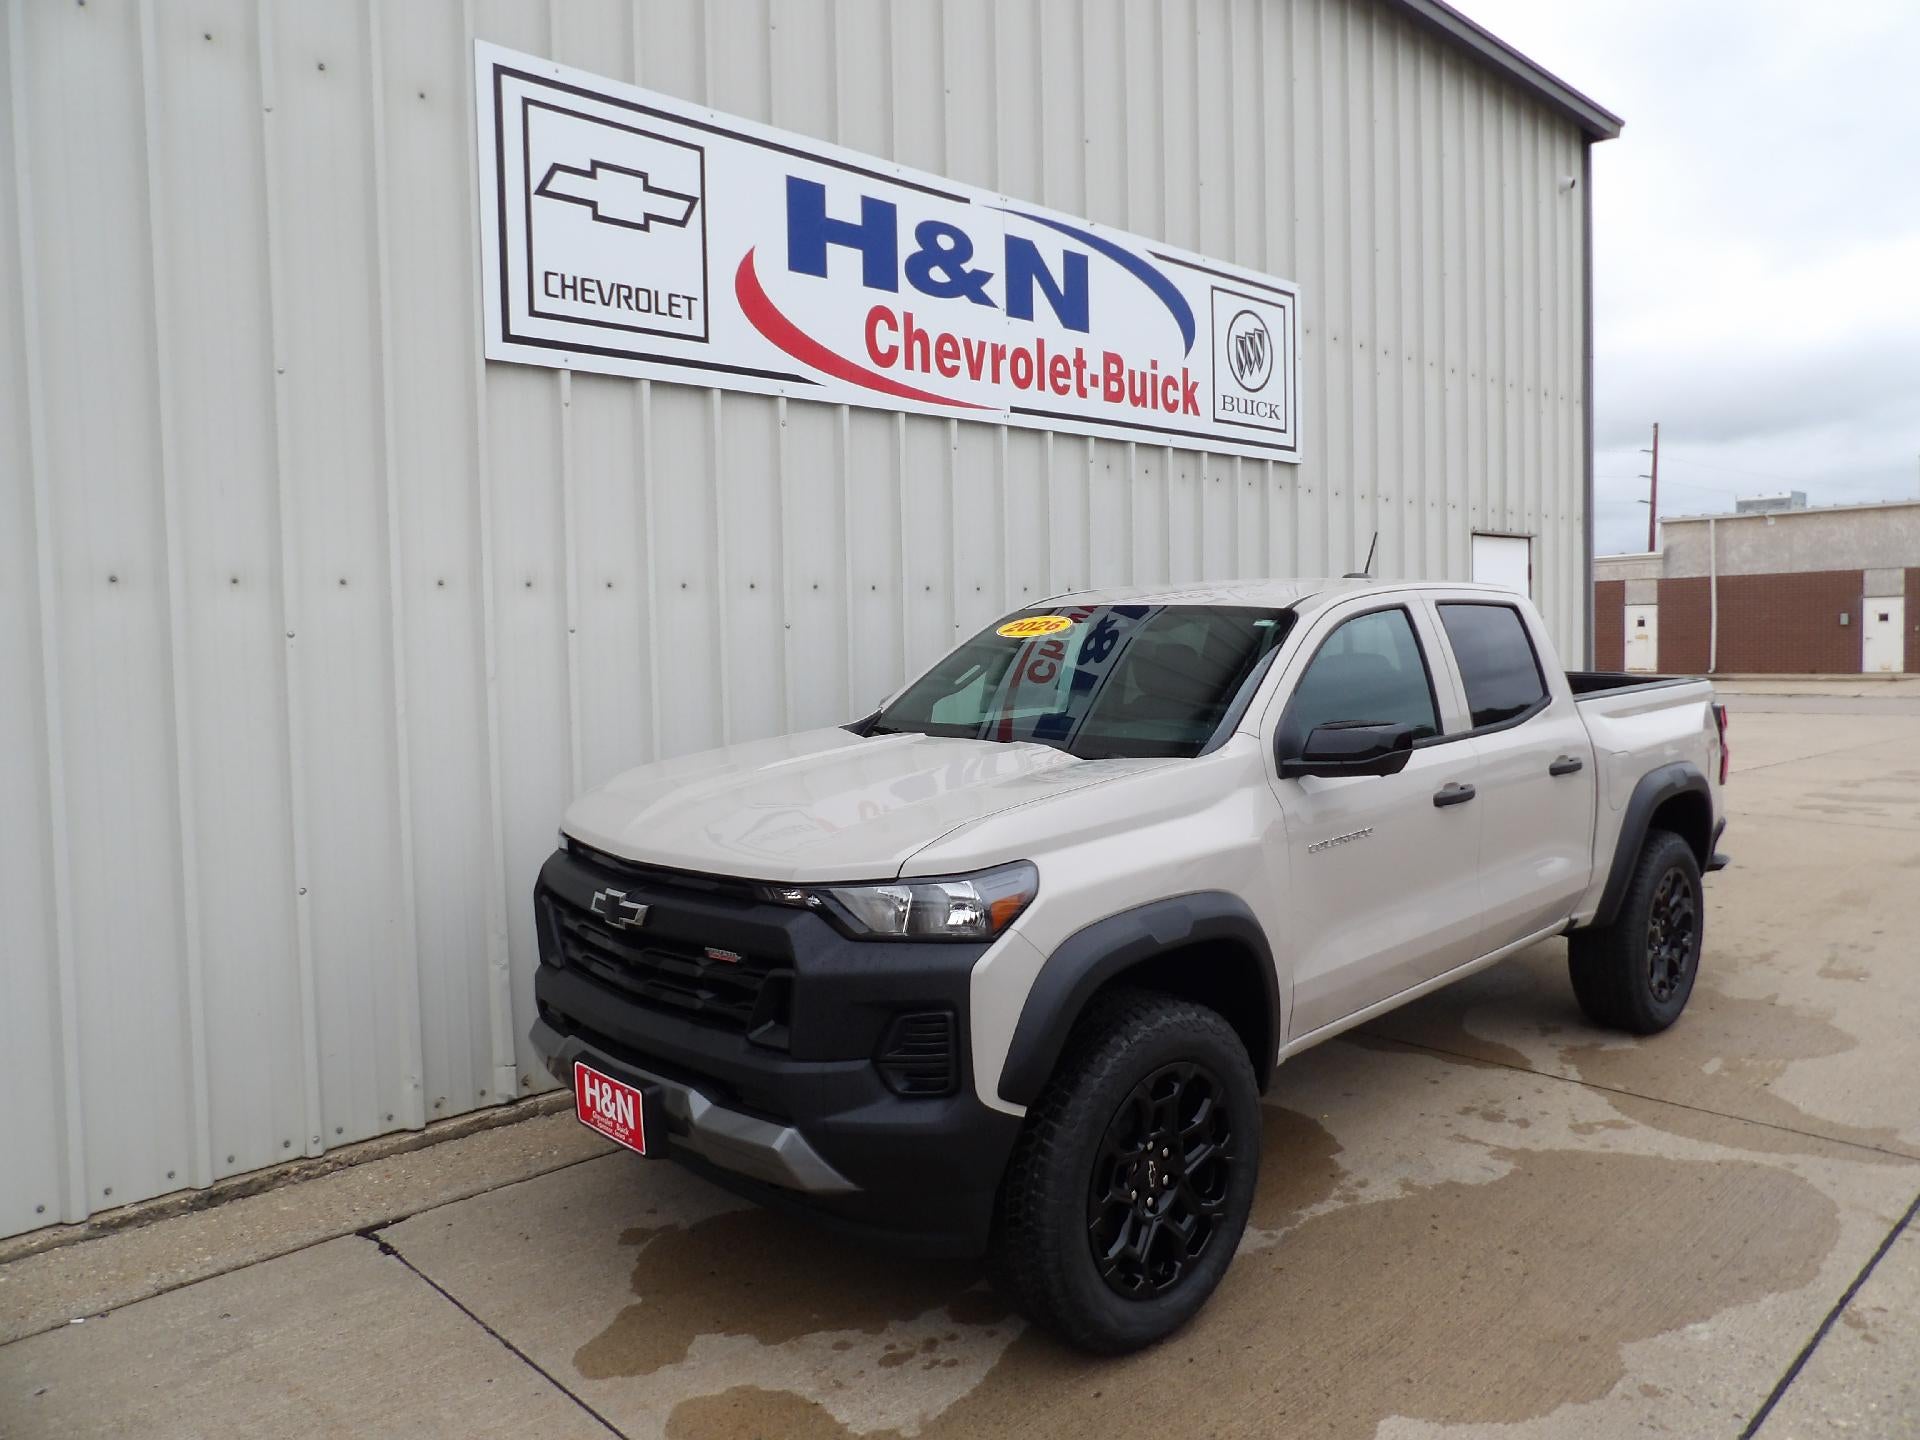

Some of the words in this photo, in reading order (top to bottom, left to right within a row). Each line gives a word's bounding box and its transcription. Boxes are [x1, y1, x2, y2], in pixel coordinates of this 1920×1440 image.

[786, 174, 1090, 334] H&N
[544, 270, 698, 321] CHEVROLET
[864, 304, 1201, 417] Chevrolet-Buick
[1220, 394, 1281, 421] BUICK
[1002, 620, 1066, 633] 2026
[584, 1072, 636, 1130] H&N
